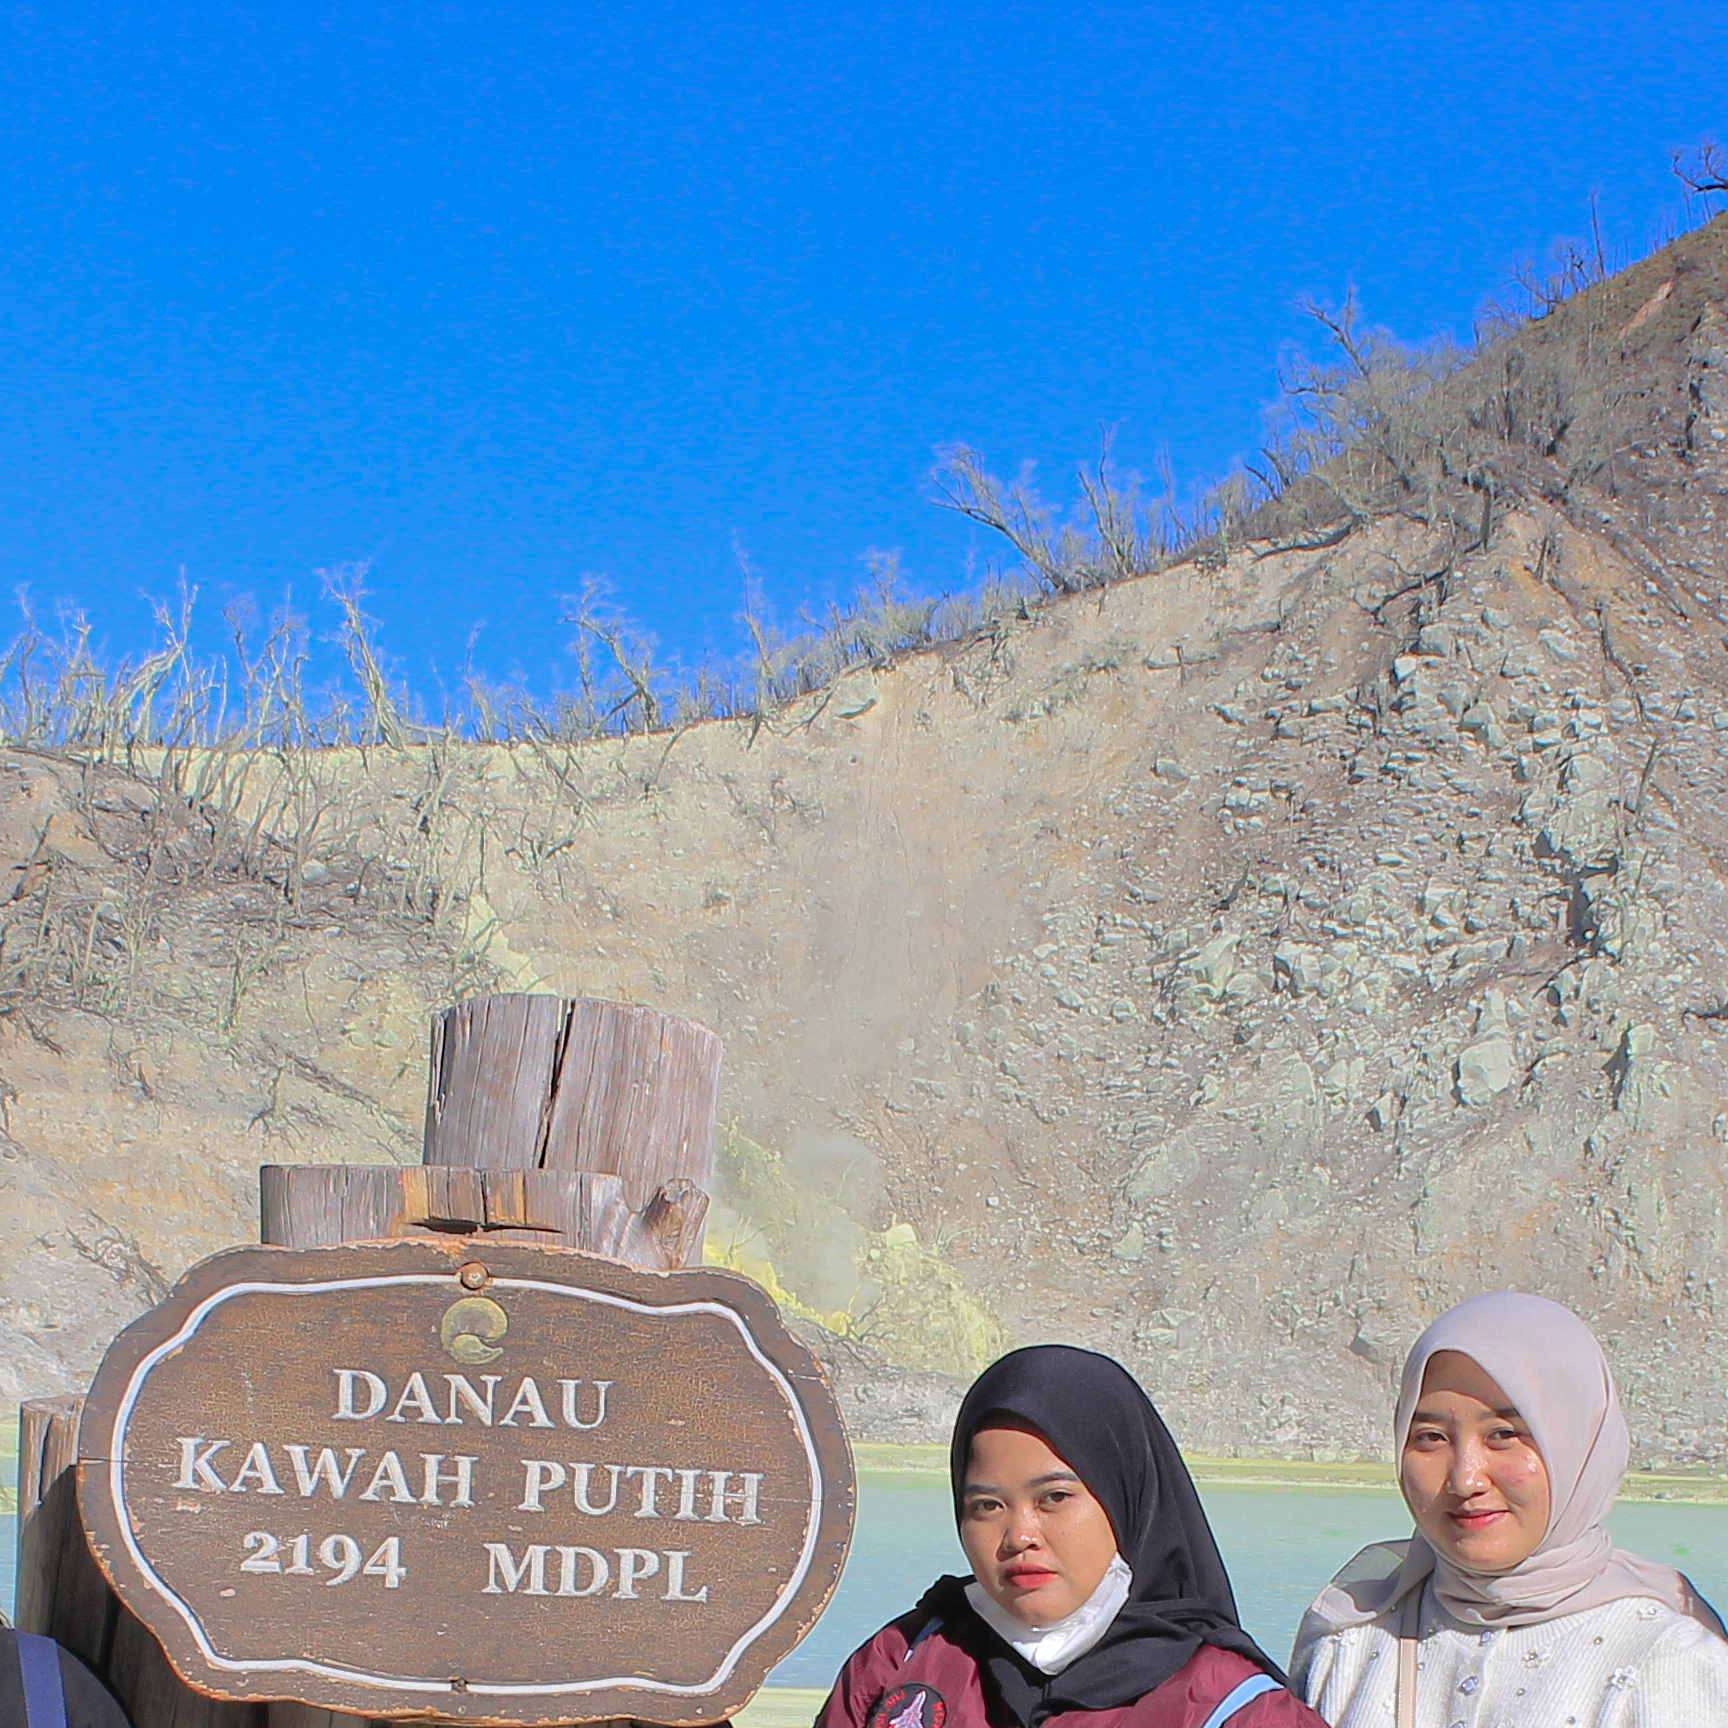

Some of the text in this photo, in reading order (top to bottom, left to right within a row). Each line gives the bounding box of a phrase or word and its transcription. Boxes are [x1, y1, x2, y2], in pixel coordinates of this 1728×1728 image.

[331, 1368, 616, 1432] DANAU
[170, 1436, 766, 1527] KAWAH PUTIH
[240, 1531, 710, 1604] 2194 MDPL
